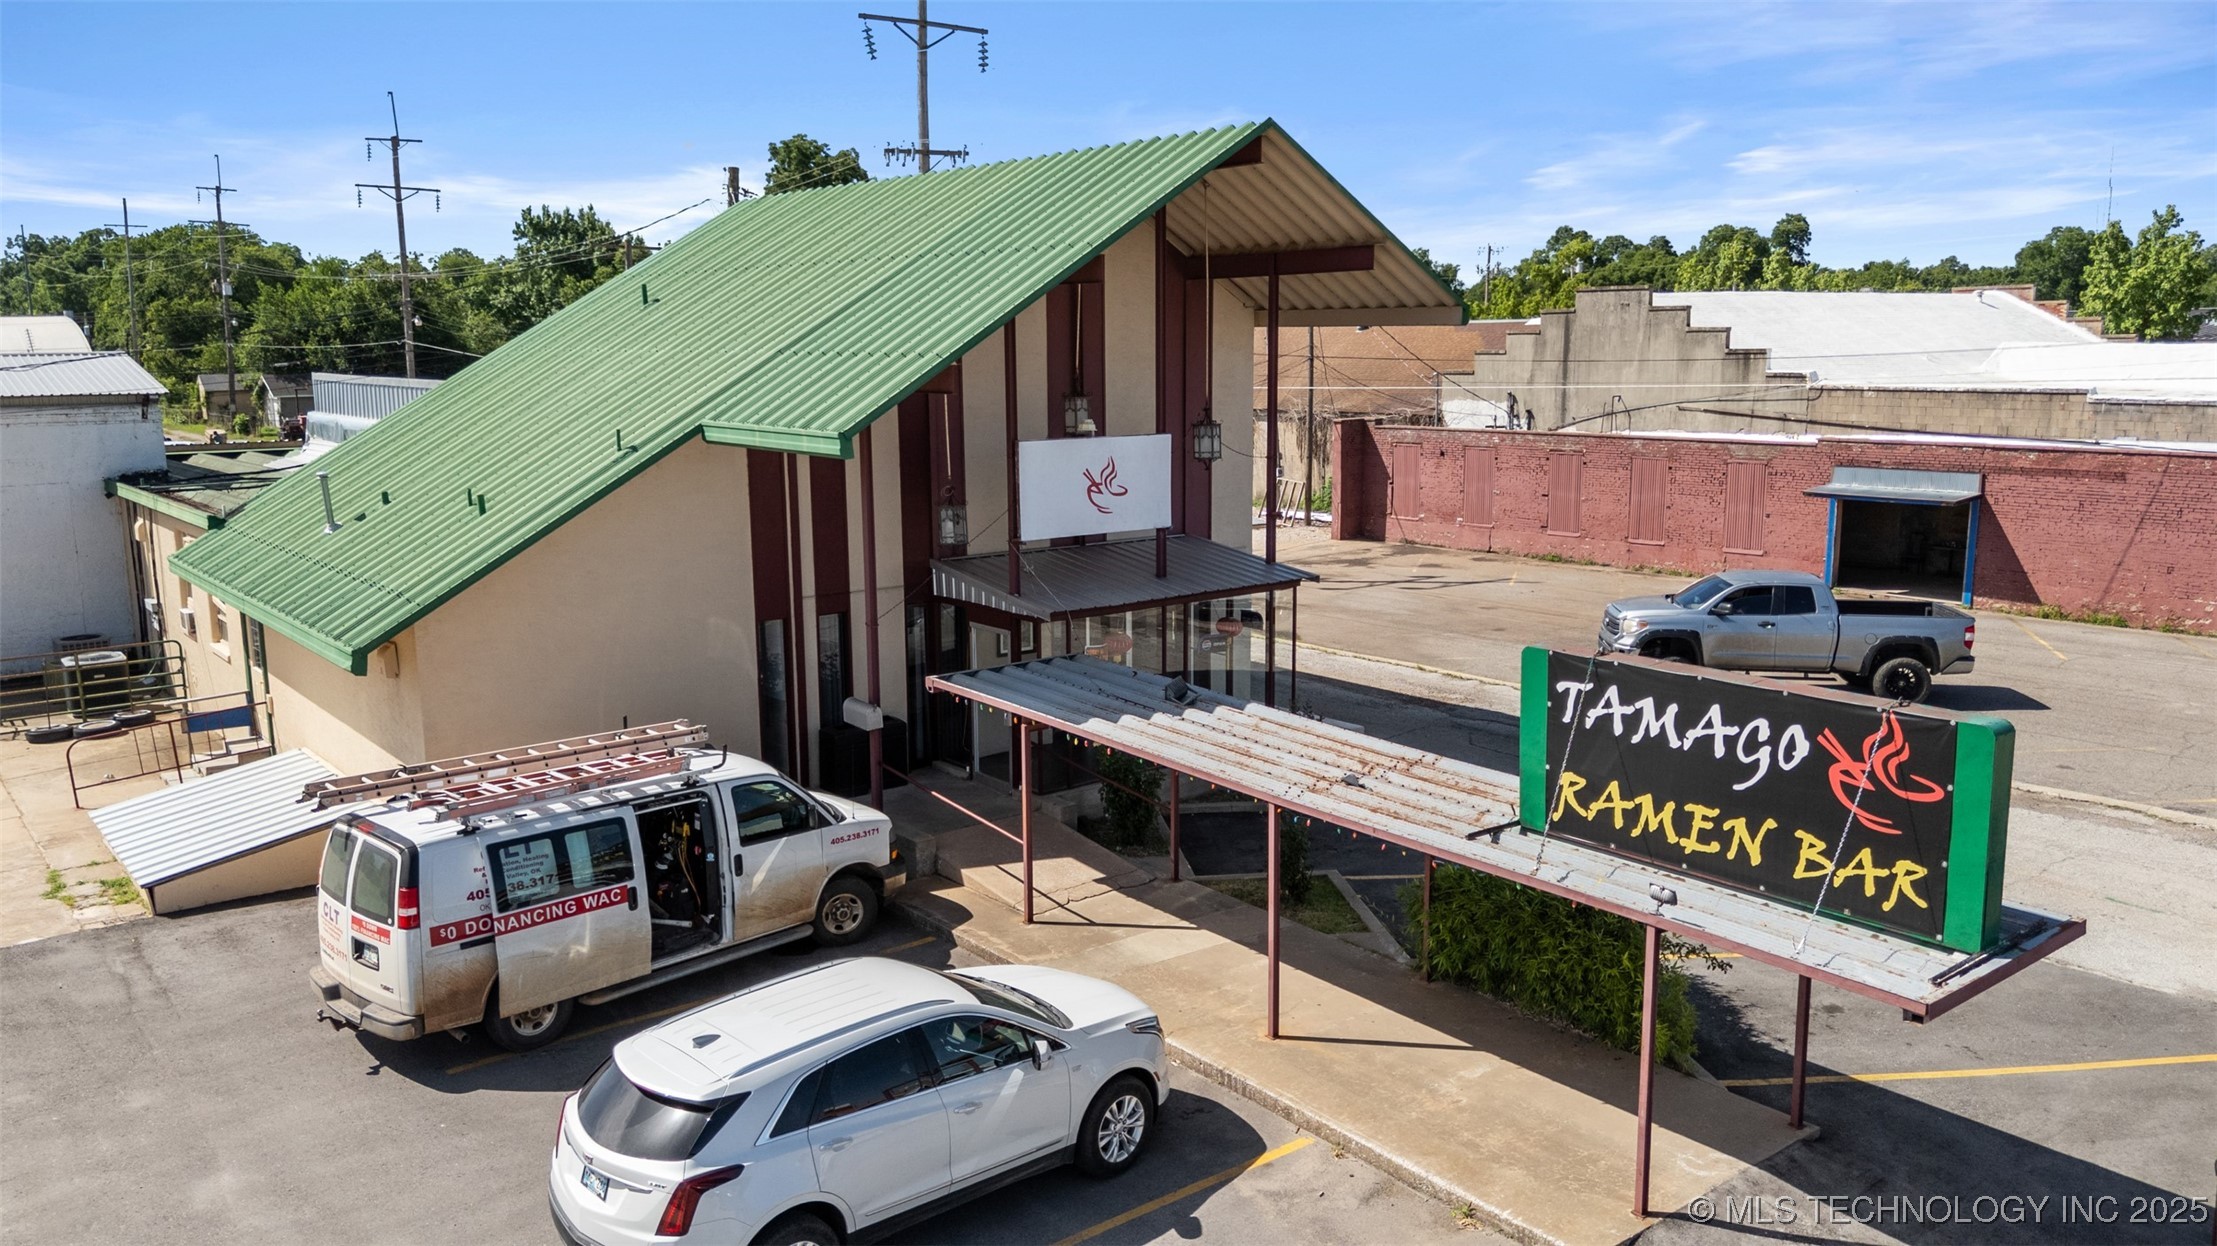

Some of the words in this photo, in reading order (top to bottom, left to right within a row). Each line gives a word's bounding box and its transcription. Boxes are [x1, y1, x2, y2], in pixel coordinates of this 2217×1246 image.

[1556, 680, 1811, 791] TAMAGO
[830, 827, 880, 845] 405.238.3171
[1552, 772, 1777, 867] RAMEN
[1792, 829, 1928, 912] BAR
[582, 888, 622, 910] WAC
[323, 901, 340, 925] CLT
[439, 926, 457, 940] $0
